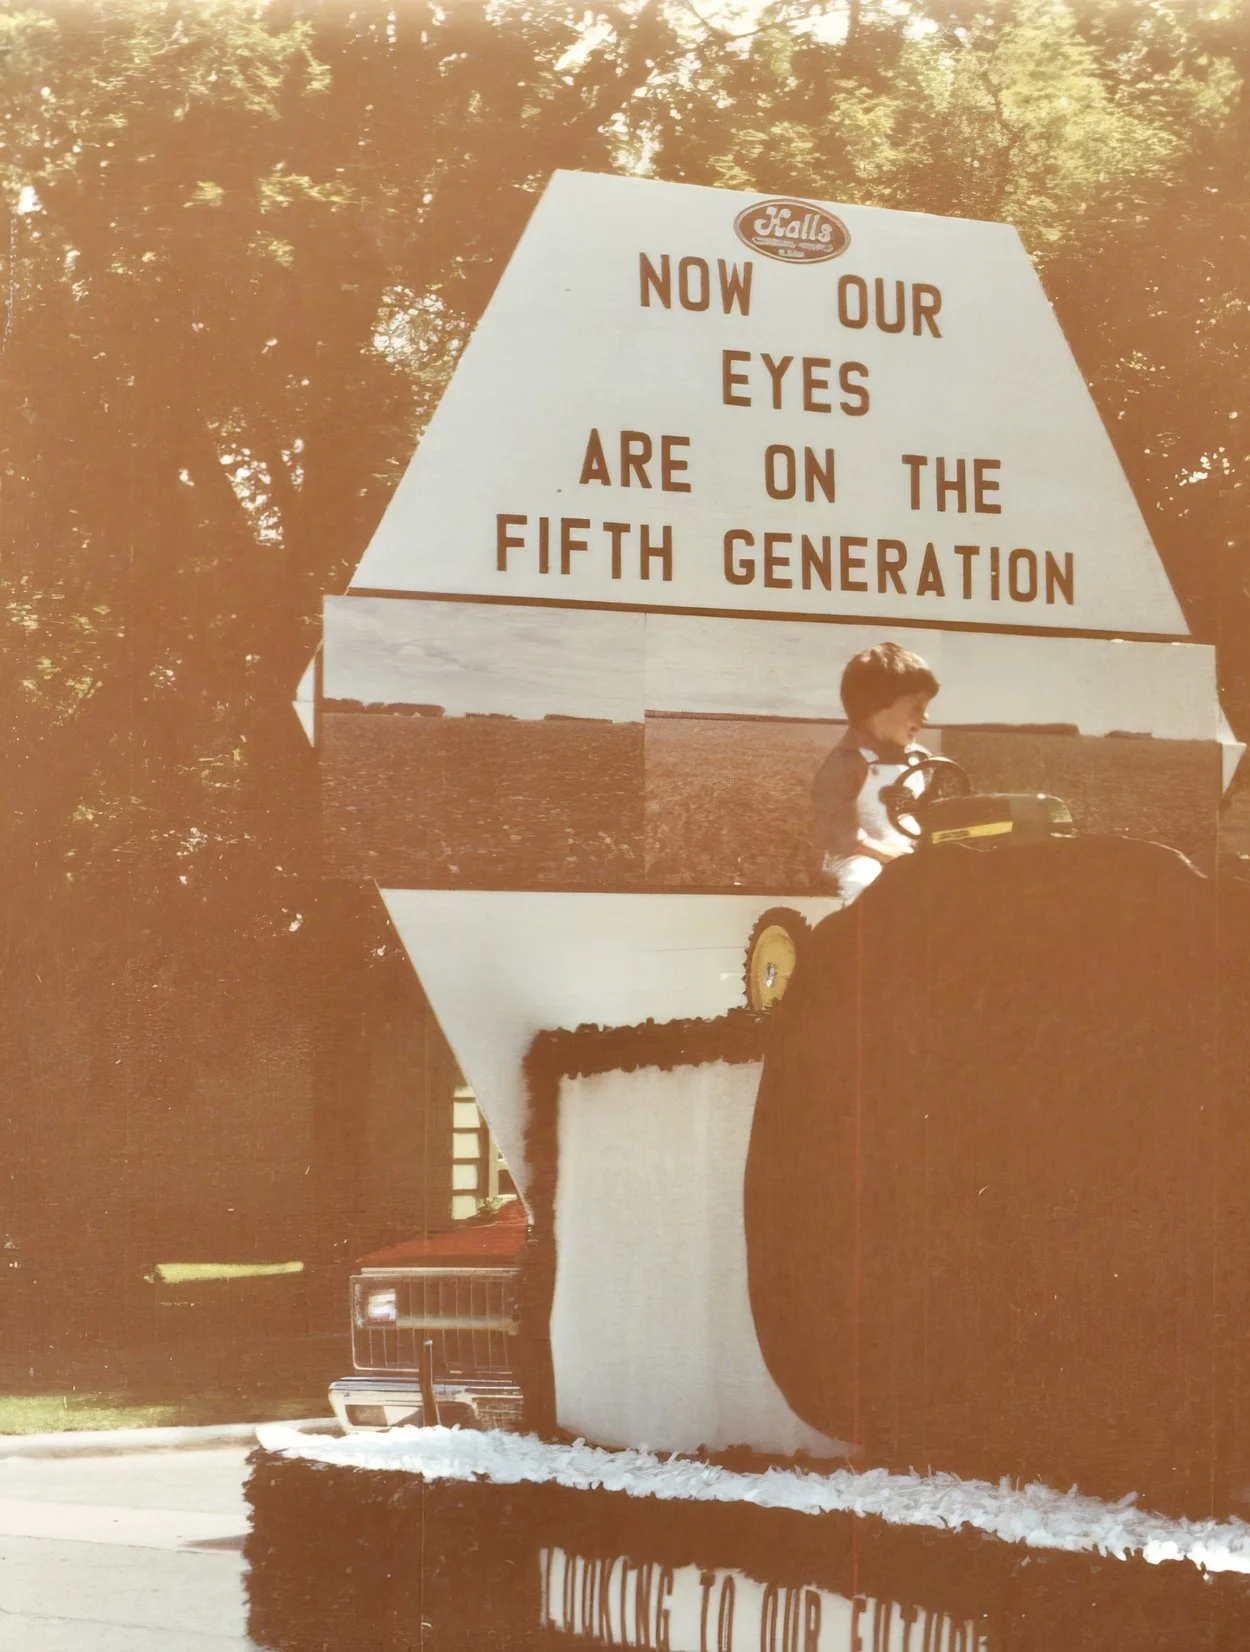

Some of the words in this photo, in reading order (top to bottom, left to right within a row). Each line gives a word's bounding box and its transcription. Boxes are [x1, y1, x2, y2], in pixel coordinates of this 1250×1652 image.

[754, 206, 833, 242] Halls
[639, 252, 754, 317] NOW
[837, 274, 943, 338] OUR
[722, 349, 870, 417] EYES
[579, 427, 692, 494] ARE
[764, 443, 836, 504] ON
[902, 454, 1002, 515] THE
[496, 513, 673, 582] FIFTH
[724, 528, 1076, 606] GENERATION
[546, 1546, 673, 1649] LOOKING
[697, 1568, 736, 1652] TO
[760, 1582, 821, 1652] OUR
